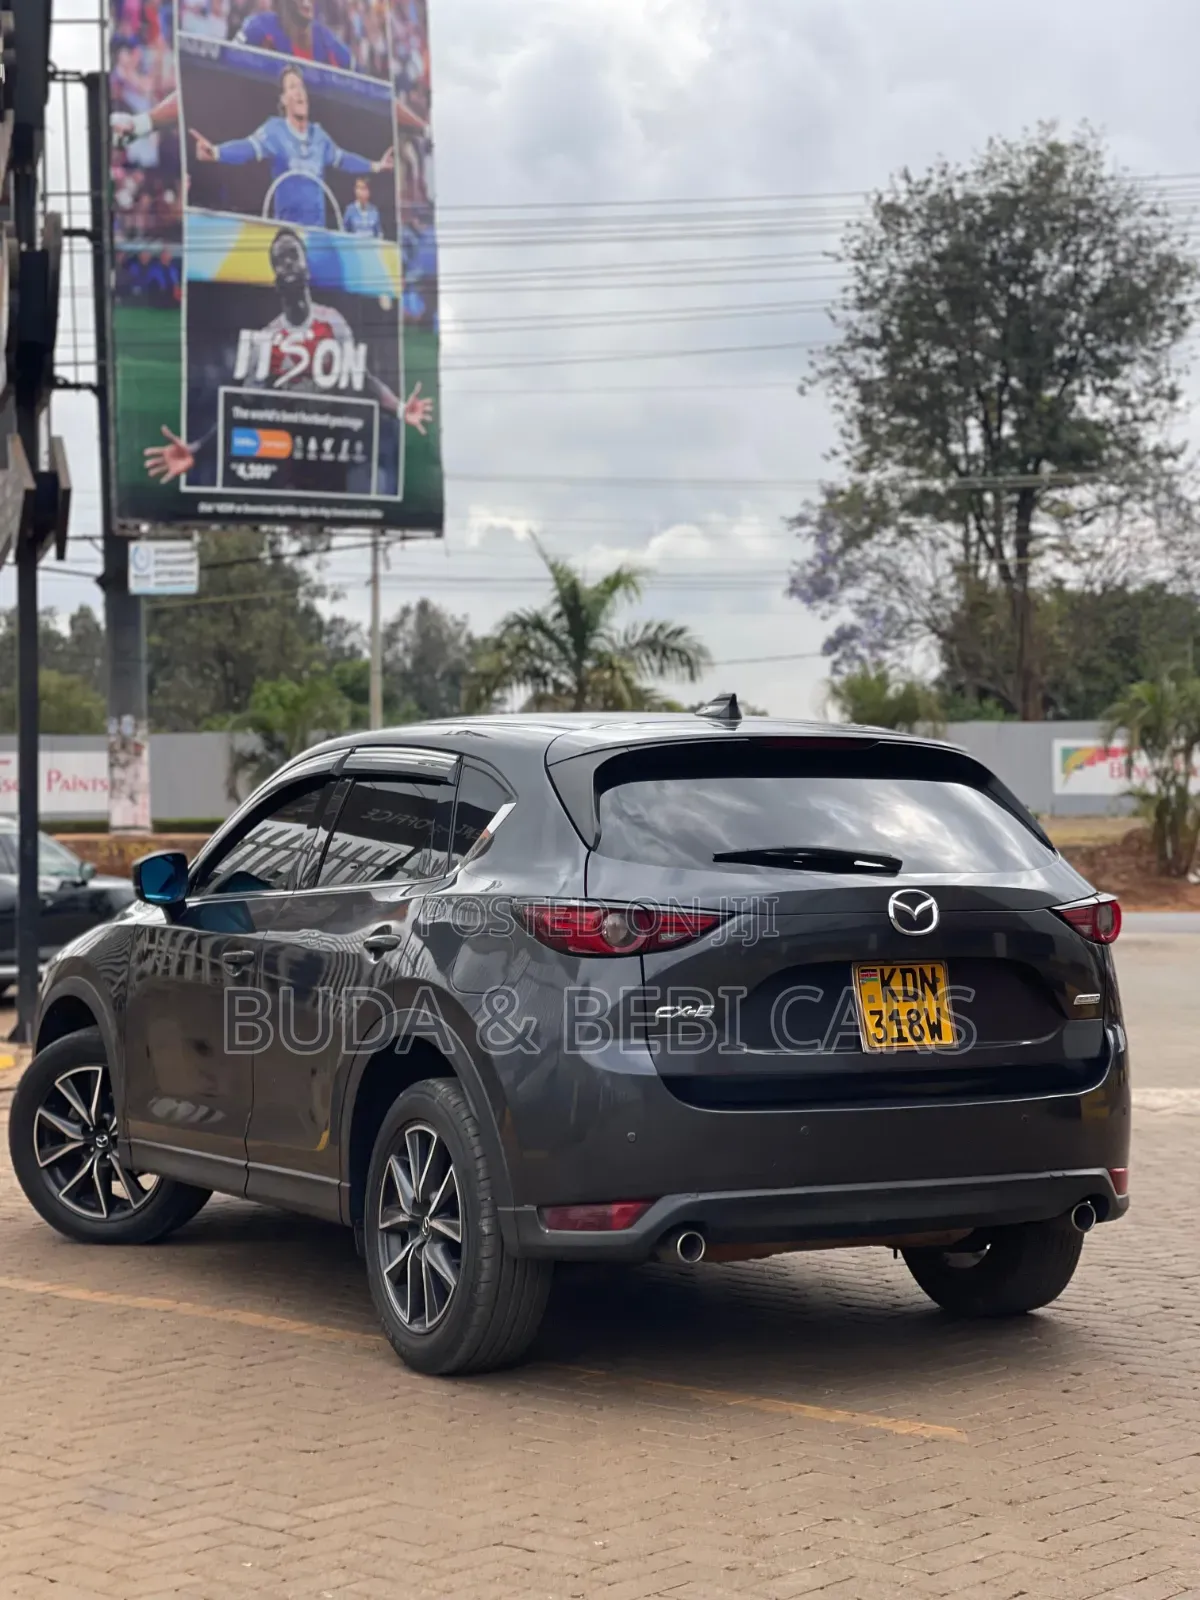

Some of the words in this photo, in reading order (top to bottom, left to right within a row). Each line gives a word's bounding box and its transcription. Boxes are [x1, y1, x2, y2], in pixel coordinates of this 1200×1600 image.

[233, 328, 313, 388] IT'S
[312, 338, 368, 391] ON
[232, 406, 249, 419] The
[880, 967, 939, 1003] KDN
[655, 1005, 715, 1018] CX-5
[869, 1007, 943, 1043] 318W
